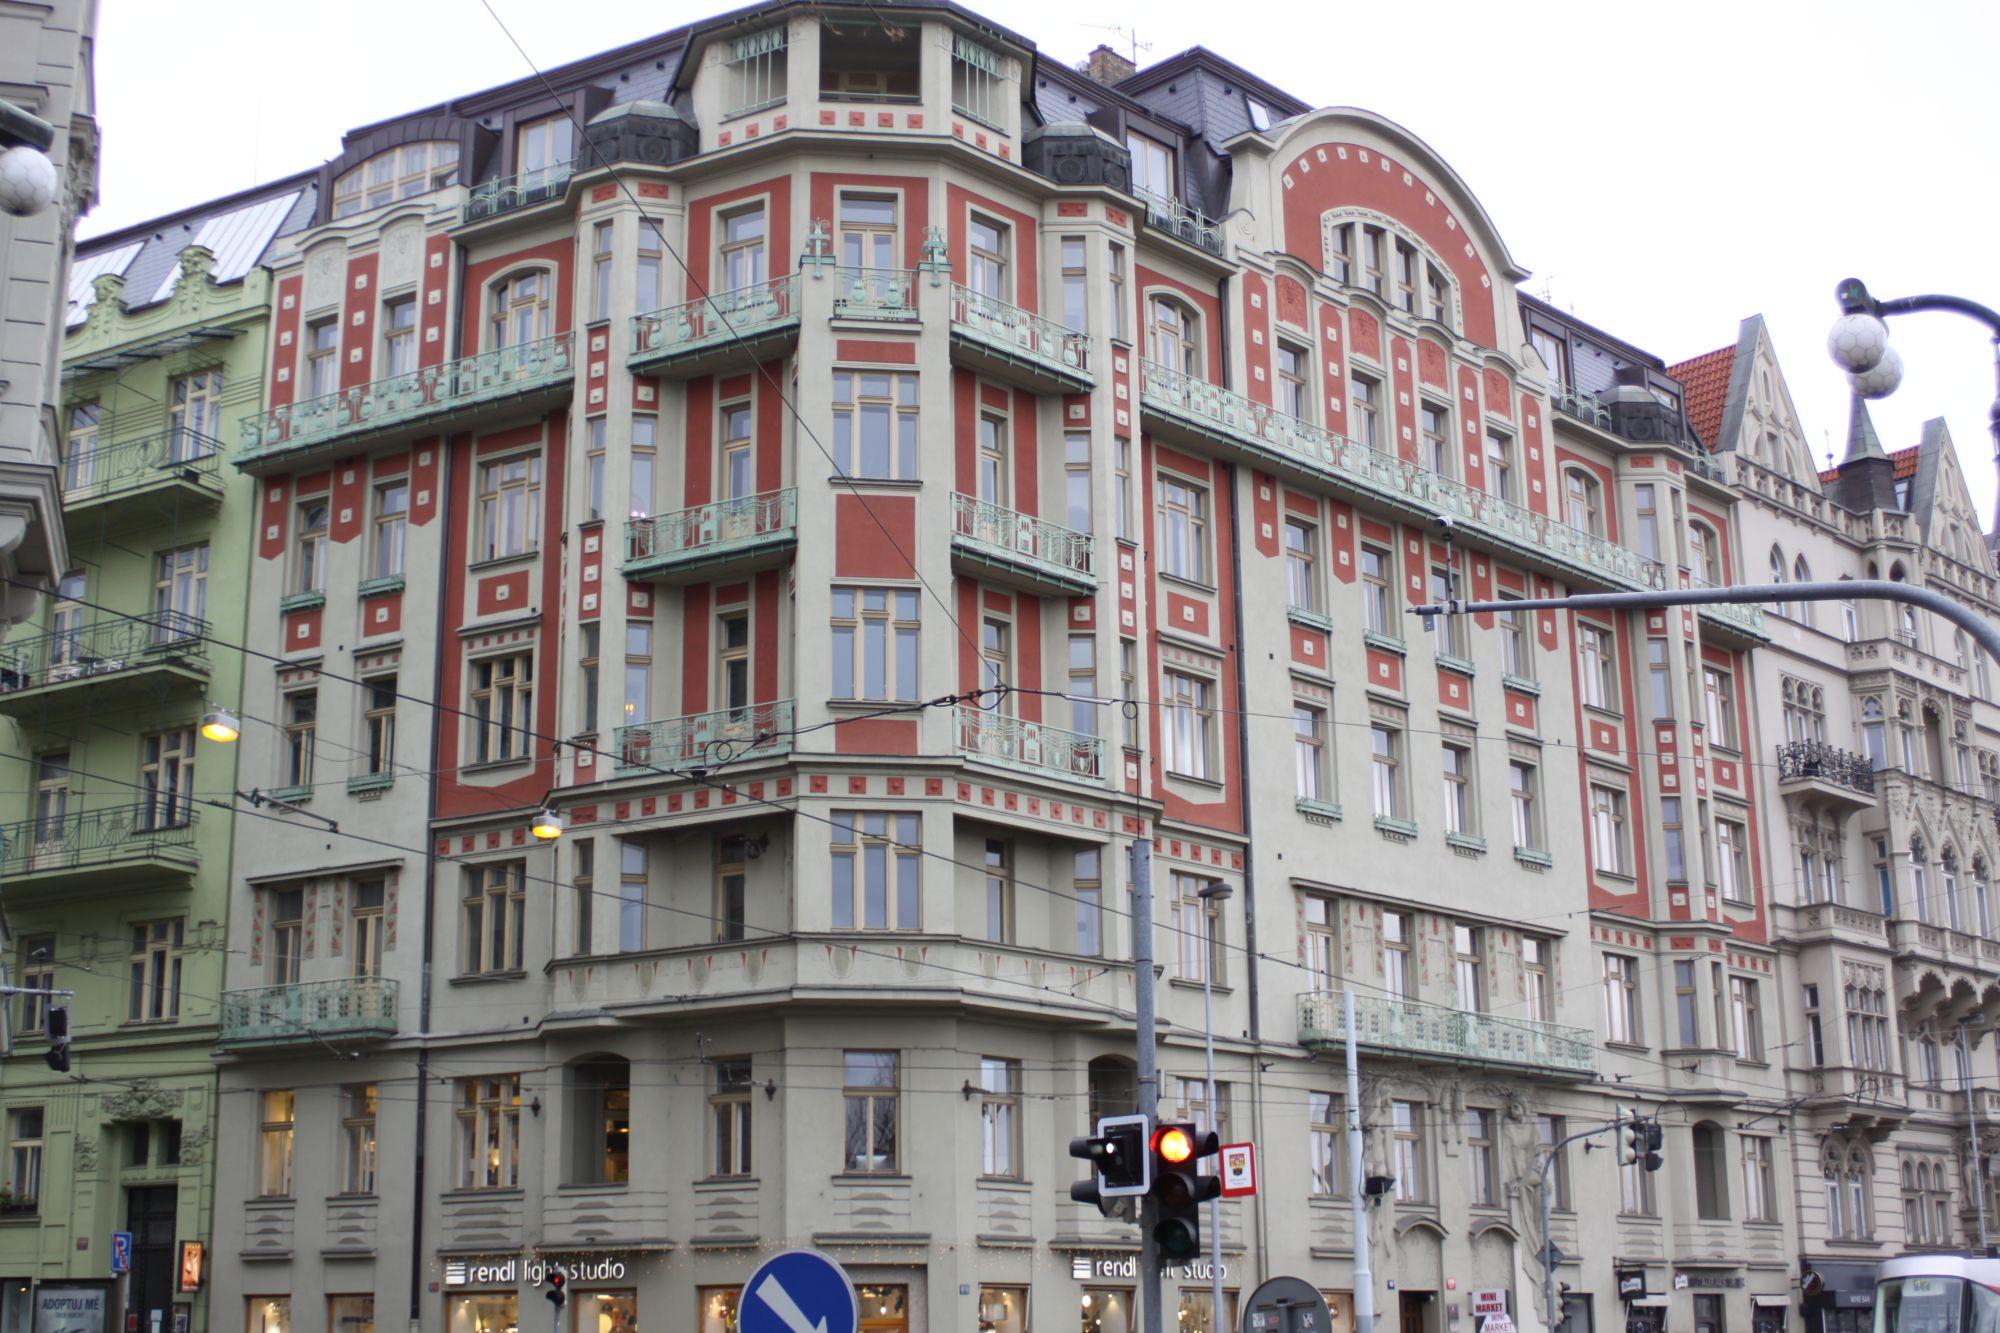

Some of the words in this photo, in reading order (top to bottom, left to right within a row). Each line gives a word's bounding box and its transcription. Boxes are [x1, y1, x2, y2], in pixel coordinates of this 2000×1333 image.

[469, 1260, 516, 1282] rendl
[524, 1259, 559, 1287] ligh
[570, 1257, 625, 1280] studio
[1095, 1256, 1137, 1277] rendl
[1184, 1263, 1228, 1279] studo
[1481, 1293, 1496, 1301] MINI
[41, 1298, 82, 1310] ADOPTUJ
[1476, 1303, 1502, 1312] MARKET
[1484, 1323, 1512, 1332] MARKET
